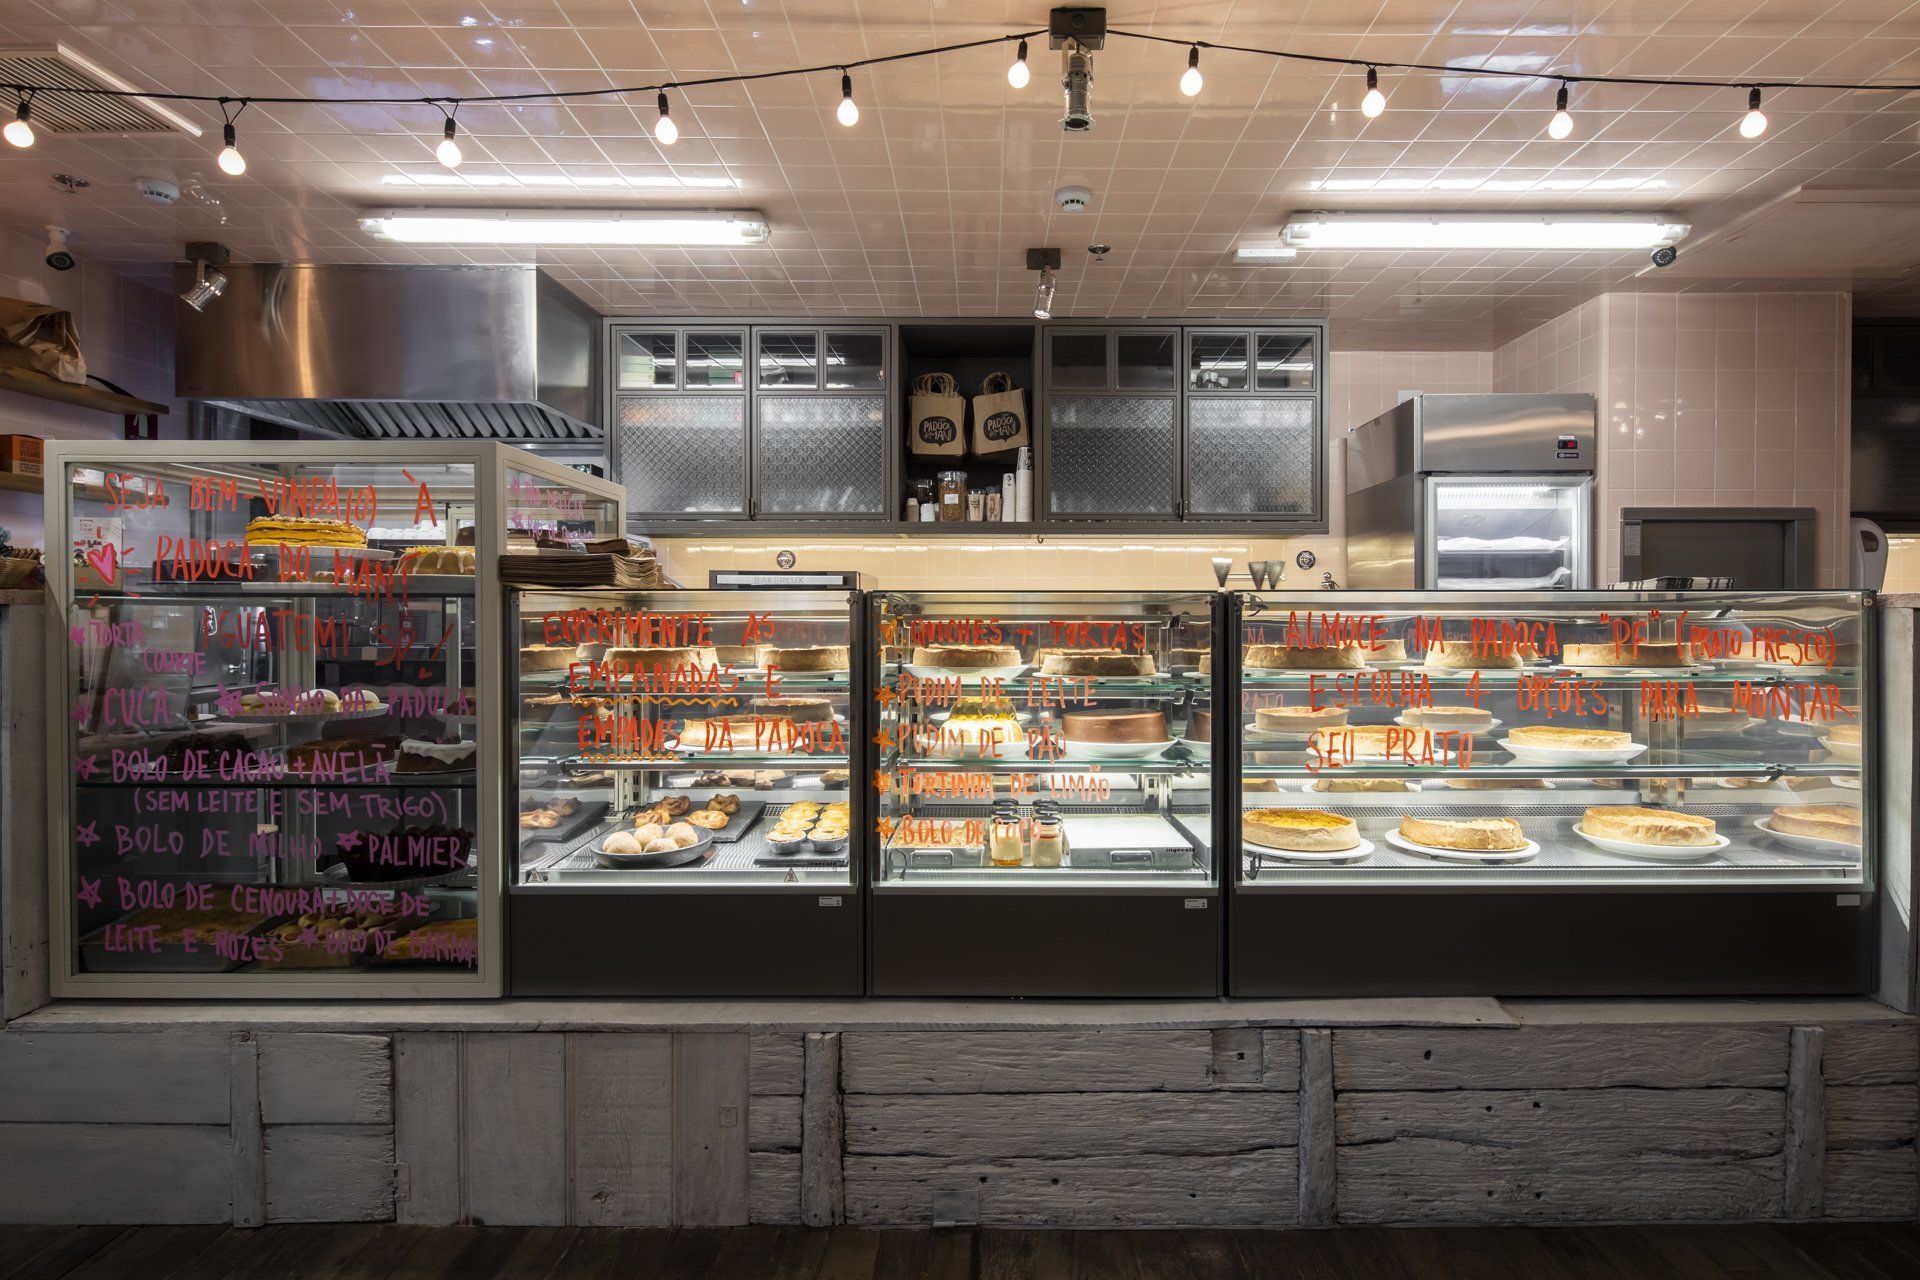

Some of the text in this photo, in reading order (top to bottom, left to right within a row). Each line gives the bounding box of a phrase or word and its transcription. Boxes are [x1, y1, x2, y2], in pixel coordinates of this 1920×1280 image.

[105, 473, 167, 512] SEJA
[402, 469, 437, 527] À
[155, 535, 253, 583] PADOCA
[279, 542, 310, 582] DO
[754, 576, 804, 584] BAKERLUX
[88, 620, 145, 648] TORTA
[202, 609, 348, 658] IGUATEMI
[543, 610, 713, 647] EXPERIMENTE
[742, 611, 775, 646] AS
[910, 617, 1000, 646] QUICHES
[1049, 620, 1146, 650] TORTAS
[1286, 611, 1388, 652] ALMOCE
[1415, 615, 1445, 654] NA
[1471, 617, 1559, 660] PADOCA
[1676, 610, 1743, 659] (PRATO
[1752, 625, 1837, 672] FRESCO)
[569, 659, 782, 698] EMPANADAS E
[899, 673, 1098, 709] PUDIM DE LEITE
[1309, 670, 1857, 722] ESCOLHA 4 OPÇÕES PARA MONTAR
[104, 685, 170, 726] CUCA
[340, 687, 367, 718] DA
[577, 715, 846, 756] EMPADAS DA PADOCA
[898, 717, 1068, 764] PUDIM DE PÃO
[1305, 727, 1473, 773] SEU PRATO
[112, 748, 168, 783] BOLO
[183, 749, 211, 782] DE
[220, 749, 285, 783] CACAU
[899, 765, 1110, 802] TORTINHA DE LIMÃO
[134, 787, 448, 824] (SEM LEITE E SEM TRIGO)
[115, 823, 322, 860] BOLO DE MILHO
[903, 814, 953, 845] BOLO
[965, 818, 987, 846] DE
[368, 834, 471, 868] PALMIER
[118, 876, 175, 911] BOLO
[186, 880, 215, 911] DE
[231, 883, 325, 916] CENOURA
[345, 887, 396, 914] DOCE
[401, 891, 430, 917] DE
[104, 924, 284, 962] LEITE E NOZES
[375, 929, 400, 956] DE
